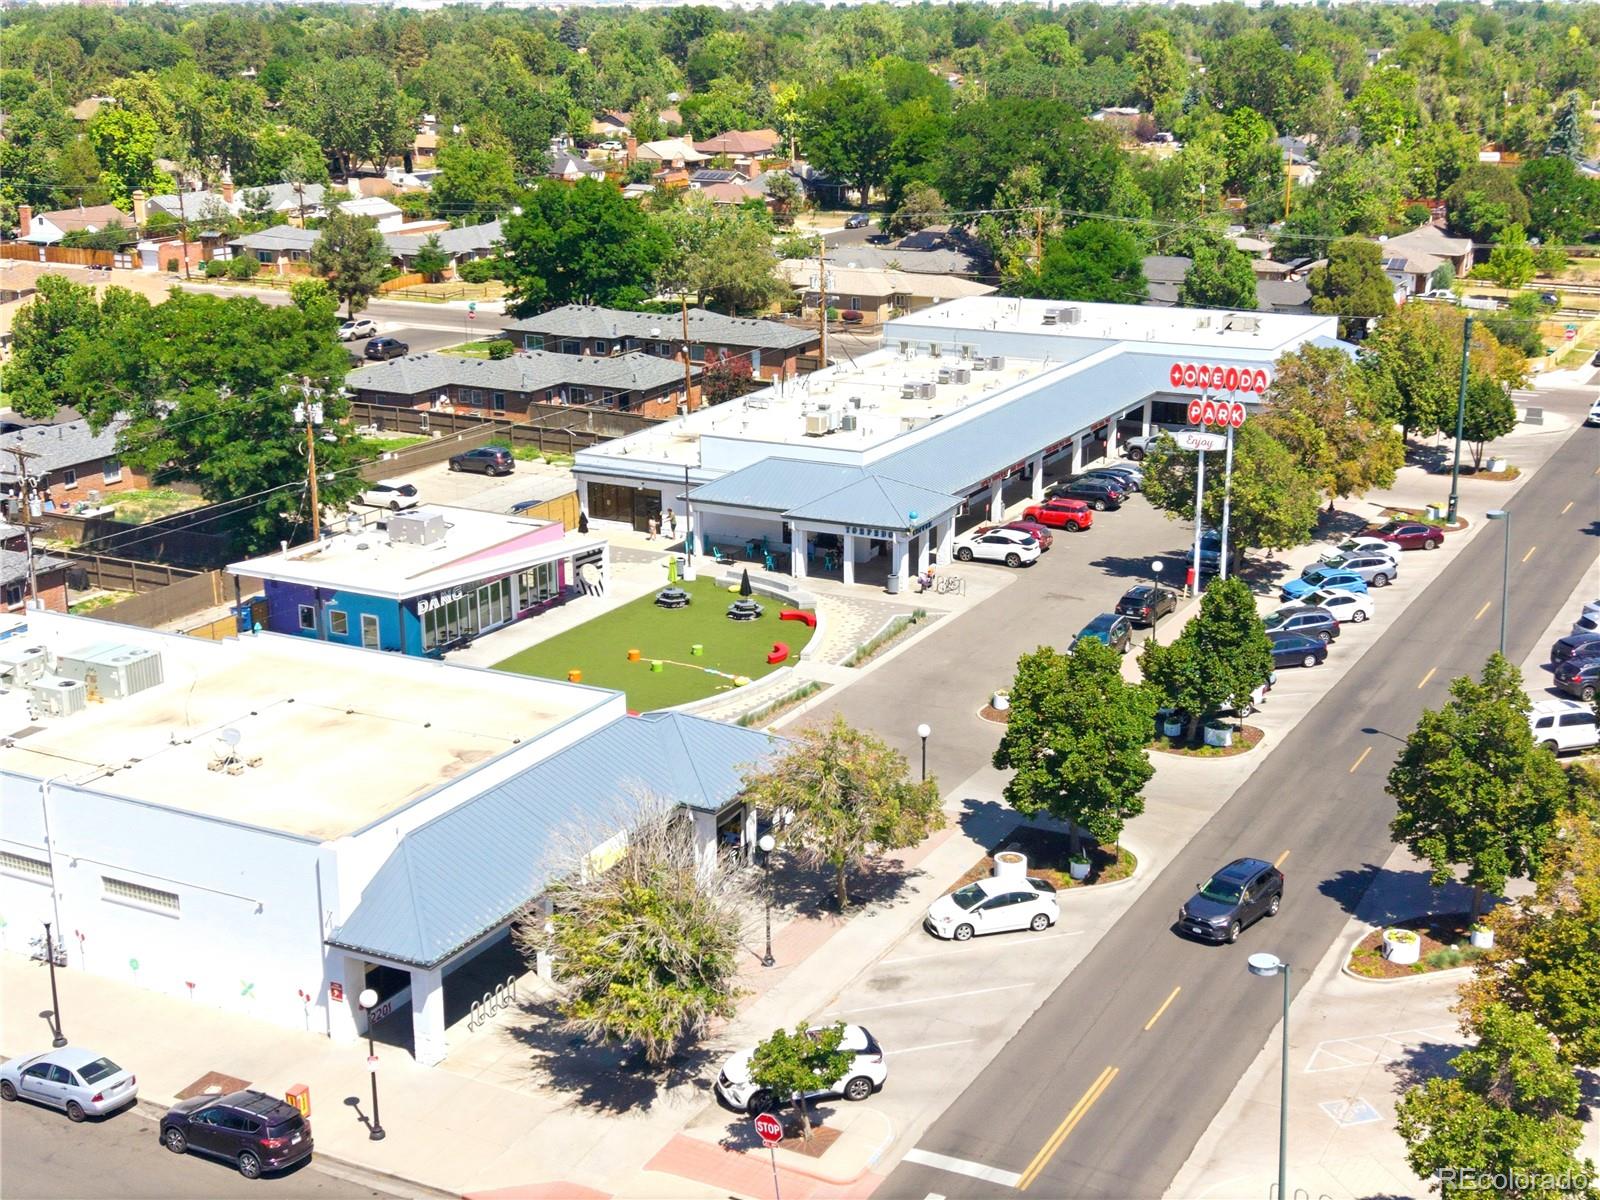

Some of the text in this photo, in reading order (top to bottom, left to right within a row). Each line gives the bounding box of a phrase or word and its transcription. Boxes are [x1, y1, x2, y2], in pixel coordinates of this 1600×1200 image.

[1184, 369, 1266, 389] ONEIDA
[1190, 405, 1242, 420] PARK
[1186, 434, 1215, 450] Enjoy
[417, 586, 463, 615] DANG
[370, 1002, 392, 1024] 2201
[757, 1121, 780, 1135] STOP
